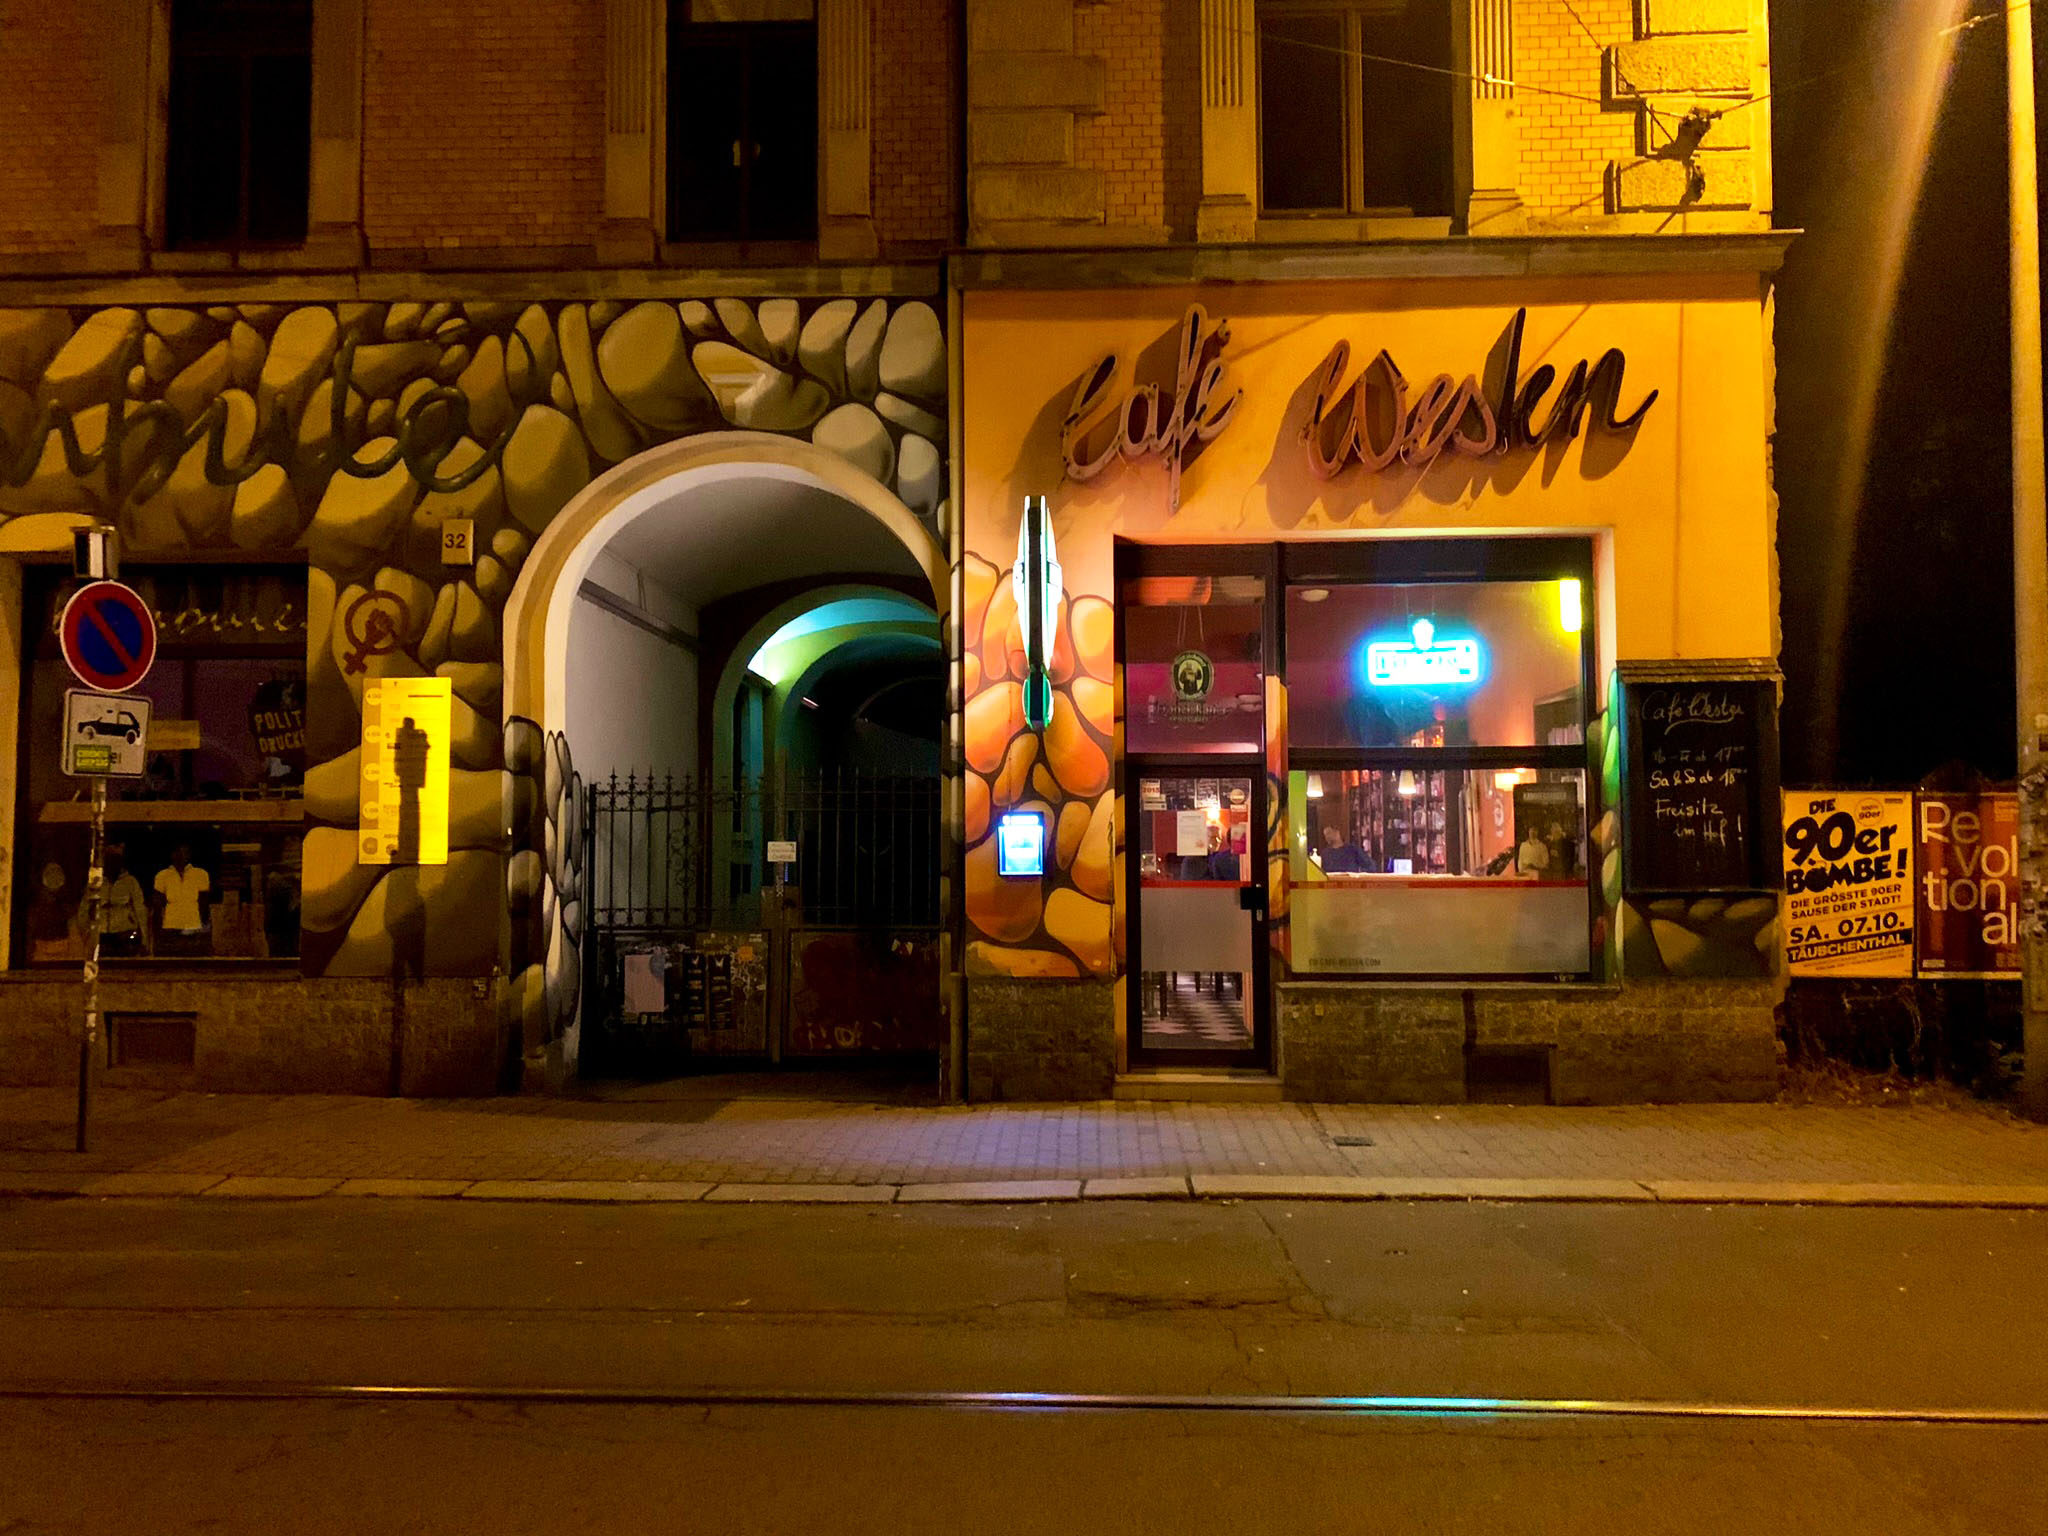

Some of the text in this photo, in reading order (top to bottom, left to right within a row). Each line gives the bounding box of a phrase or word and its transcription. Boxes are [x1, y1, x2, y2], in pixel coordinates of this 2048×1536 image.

[1299, 307, 1659, 481] Westen
[444, 533, 466, 549] 32
[1649, 770, 1669, 789] Sa
[1700, 769, 1714, 784] ab
[1655, 797, 1723, 820] Freisitz
[1809, 798, 1837, 815] DIE
[1920, 801, 1982, 846] Re
[1785, 811, 1898, 867] 90er
[1791, 883, 1902, 910] DIE GRÖSSTE 90ER
[1921, 867, 2007, 912] tion
[1791, 895, 1901, 920] SAUSE DER STADT!
[1790, 911, 1905, 944] SA. 07.10.
[1790, 933, 1905, 961] TÄUBCHENTHAL
